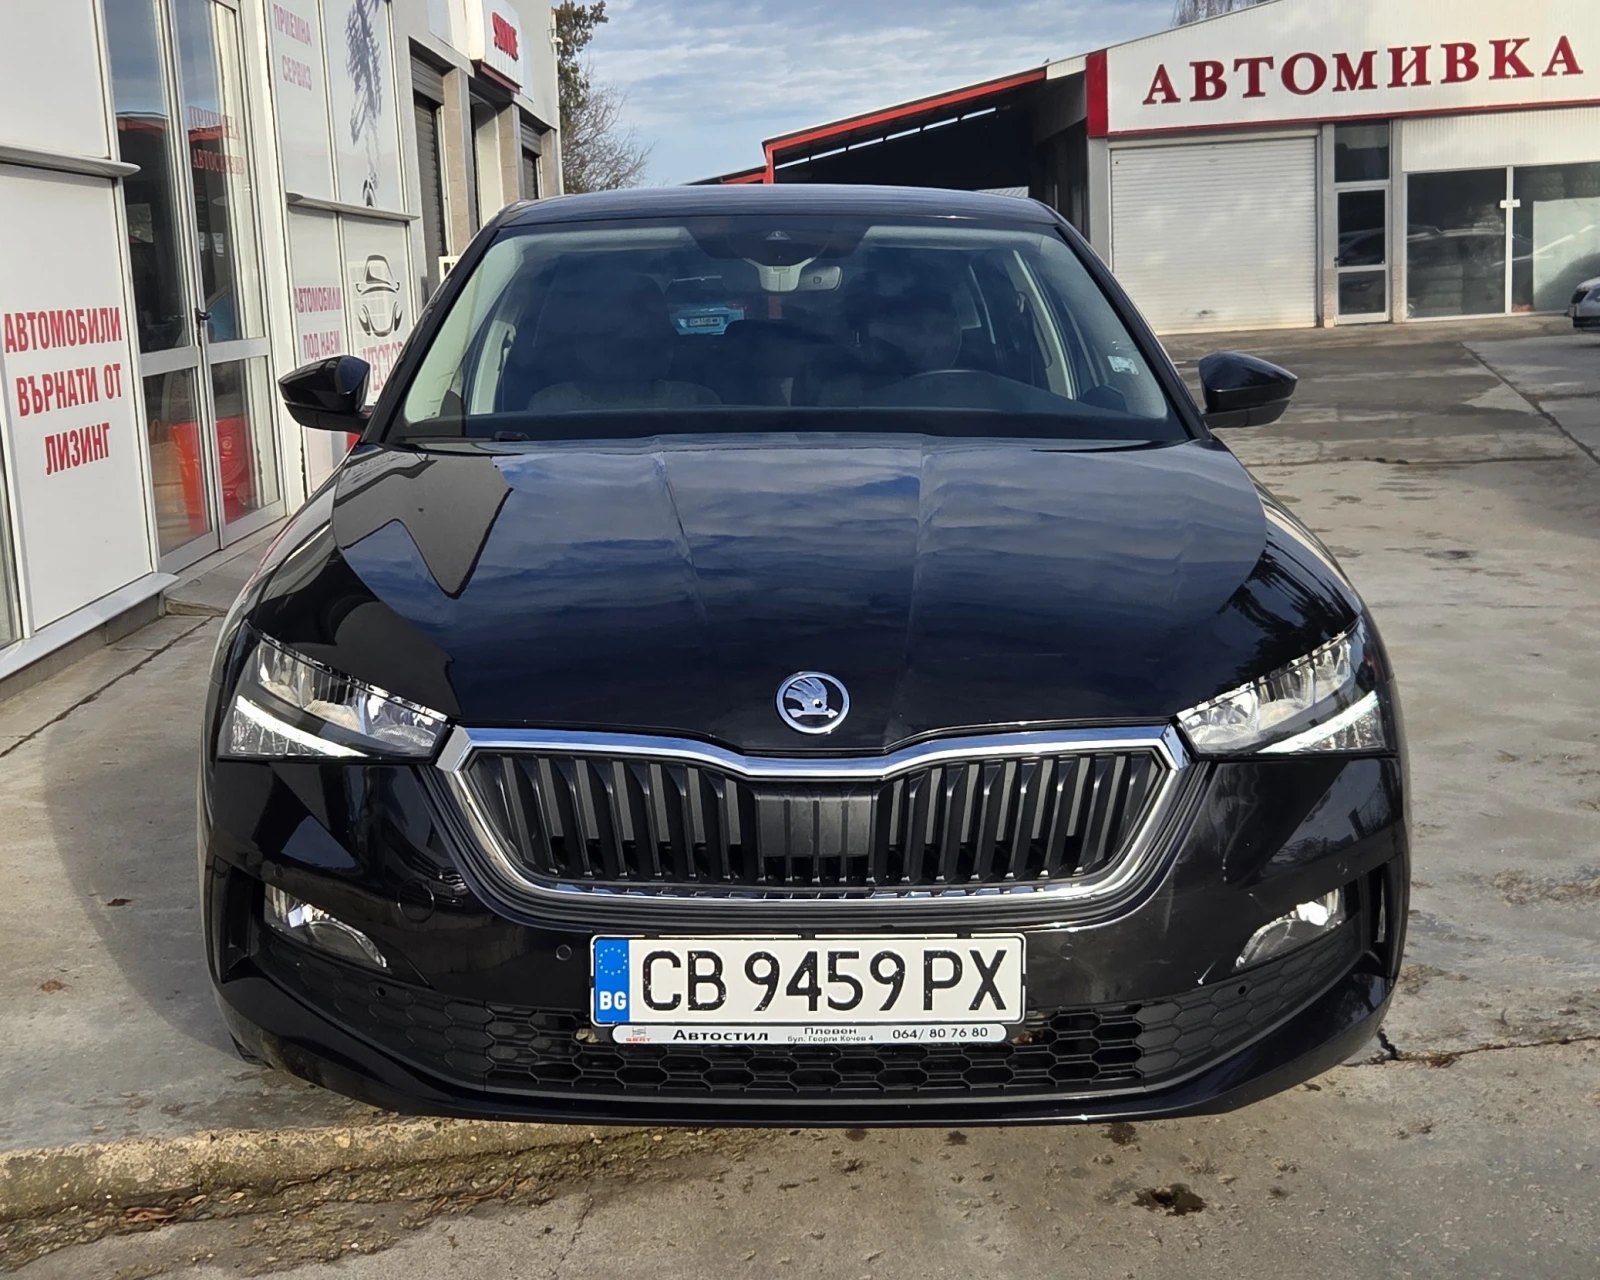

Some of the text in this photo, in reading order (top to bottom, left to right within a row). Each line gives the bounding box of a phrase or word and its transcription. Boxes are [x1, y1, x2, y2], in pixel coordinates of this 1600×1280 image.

[282, 54, 312, 91] СЕРВИЗ
[1142, 35, 1583, 105] АВТОМИВКА
[293, 286, 343, 314] АВТОМОБИЛИ
[4, 307, 122, 354] АВТОМОБИЛИ
[302, 330, 341, 361] ПОД НАЕМ
[16, 363, 122, 417] ВЪРНАТИ ОТ
[45, 422, 110, 475] ЛИЗИНГ
[744, 950, 906, 1012] 9459
[600, 990, 627, 1010] BG
[672, 1029, 769, 1041] Автостил
[787, 1035, 806, 1044] бул.
[808, 1035, 838, 1044] Георги
[868, 1034, 874, 1042] 4
[892, 1027, 988, 1040] 064/ 80 76 80
